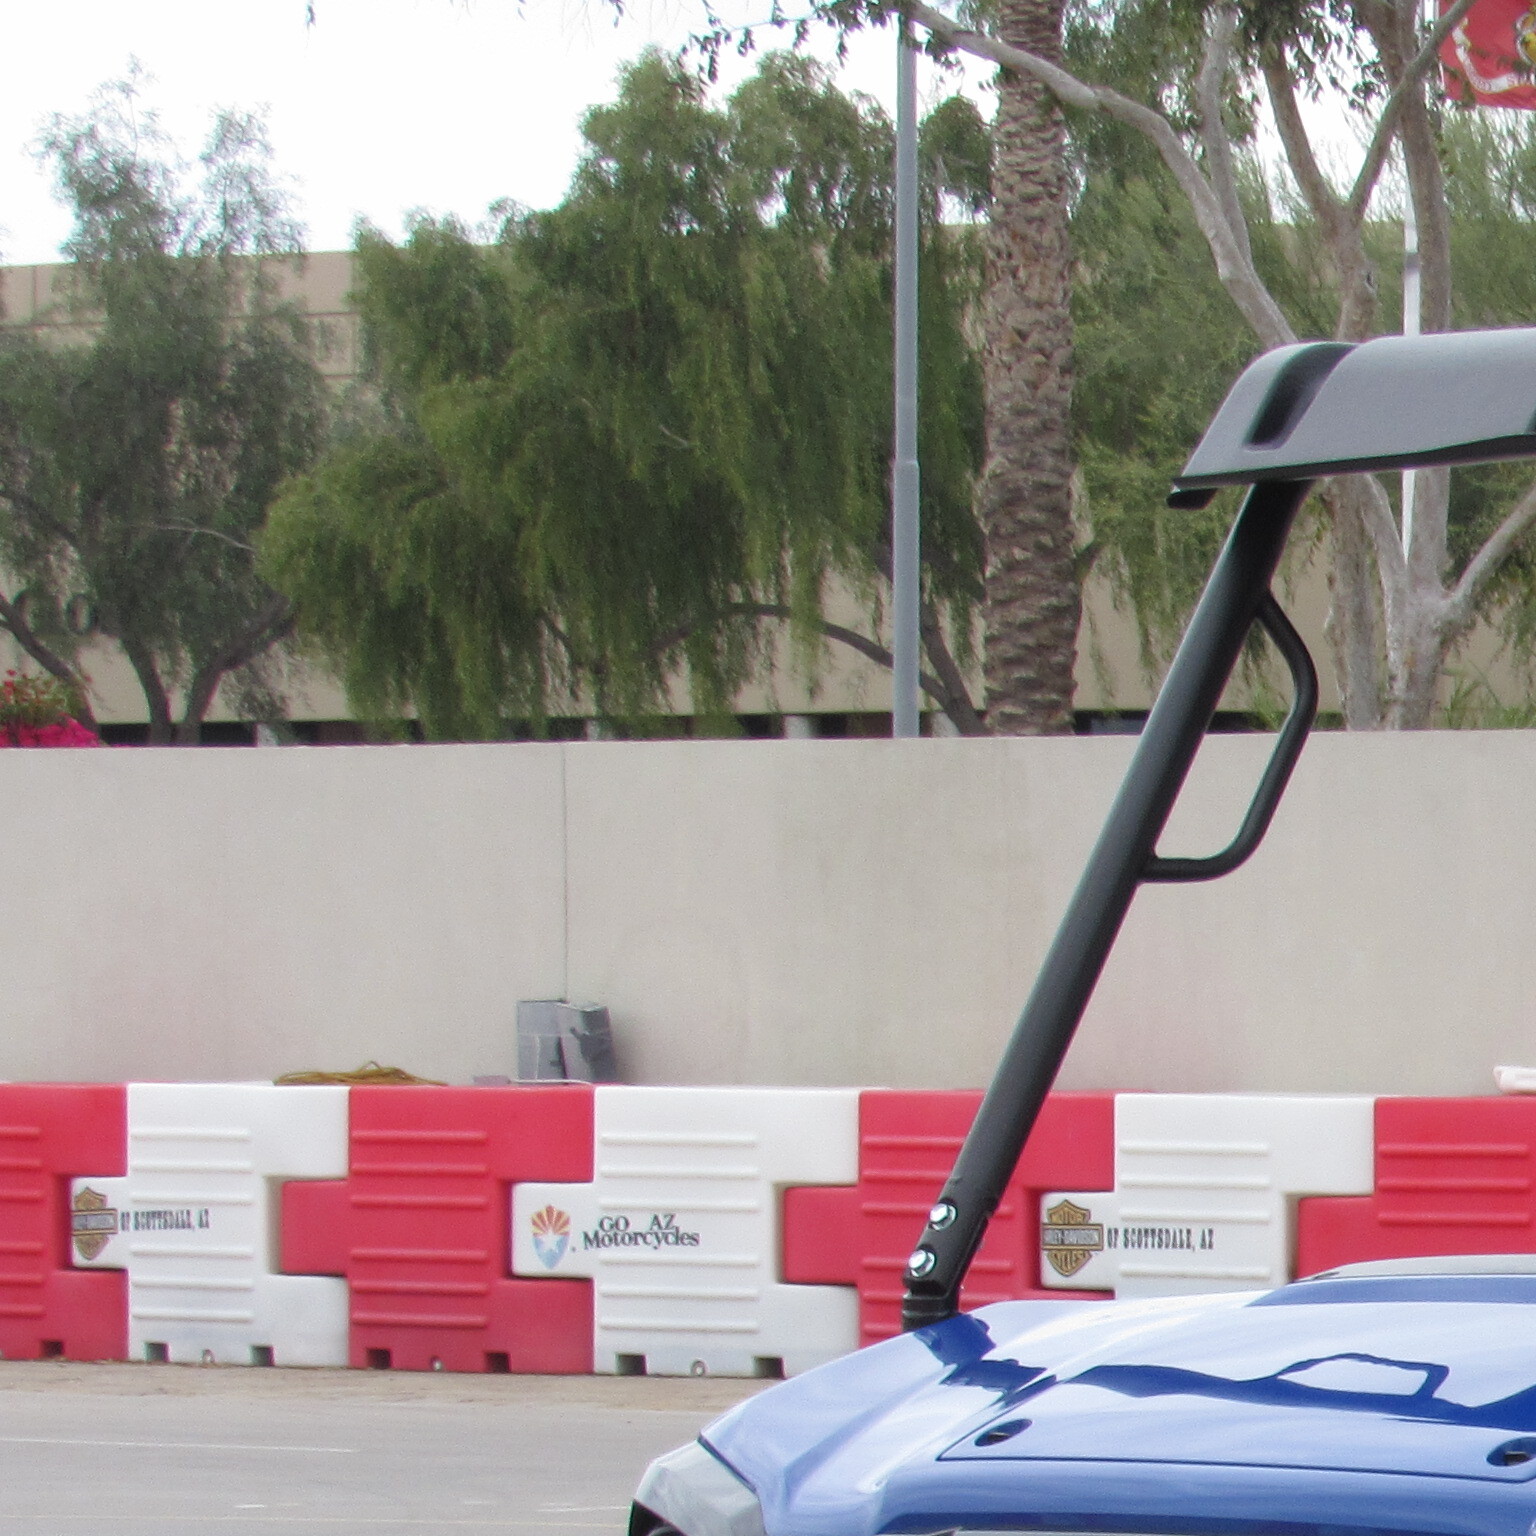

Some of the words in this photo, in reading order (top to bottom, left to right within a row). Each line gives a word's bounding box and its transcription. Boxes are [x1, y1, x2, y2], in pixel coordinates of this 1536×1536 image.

[600, 1216, 630, 1232] GO
[650, 1213, 676, 1231] AZ
[582, 1227, 700, 1250] Motorcycles
[1107, 1228, 1119, 1249] OF
[1123, 1228, 1195, 1252] SCOTTSDALE,
[1200, 1228, 1214, 1249] AZ
